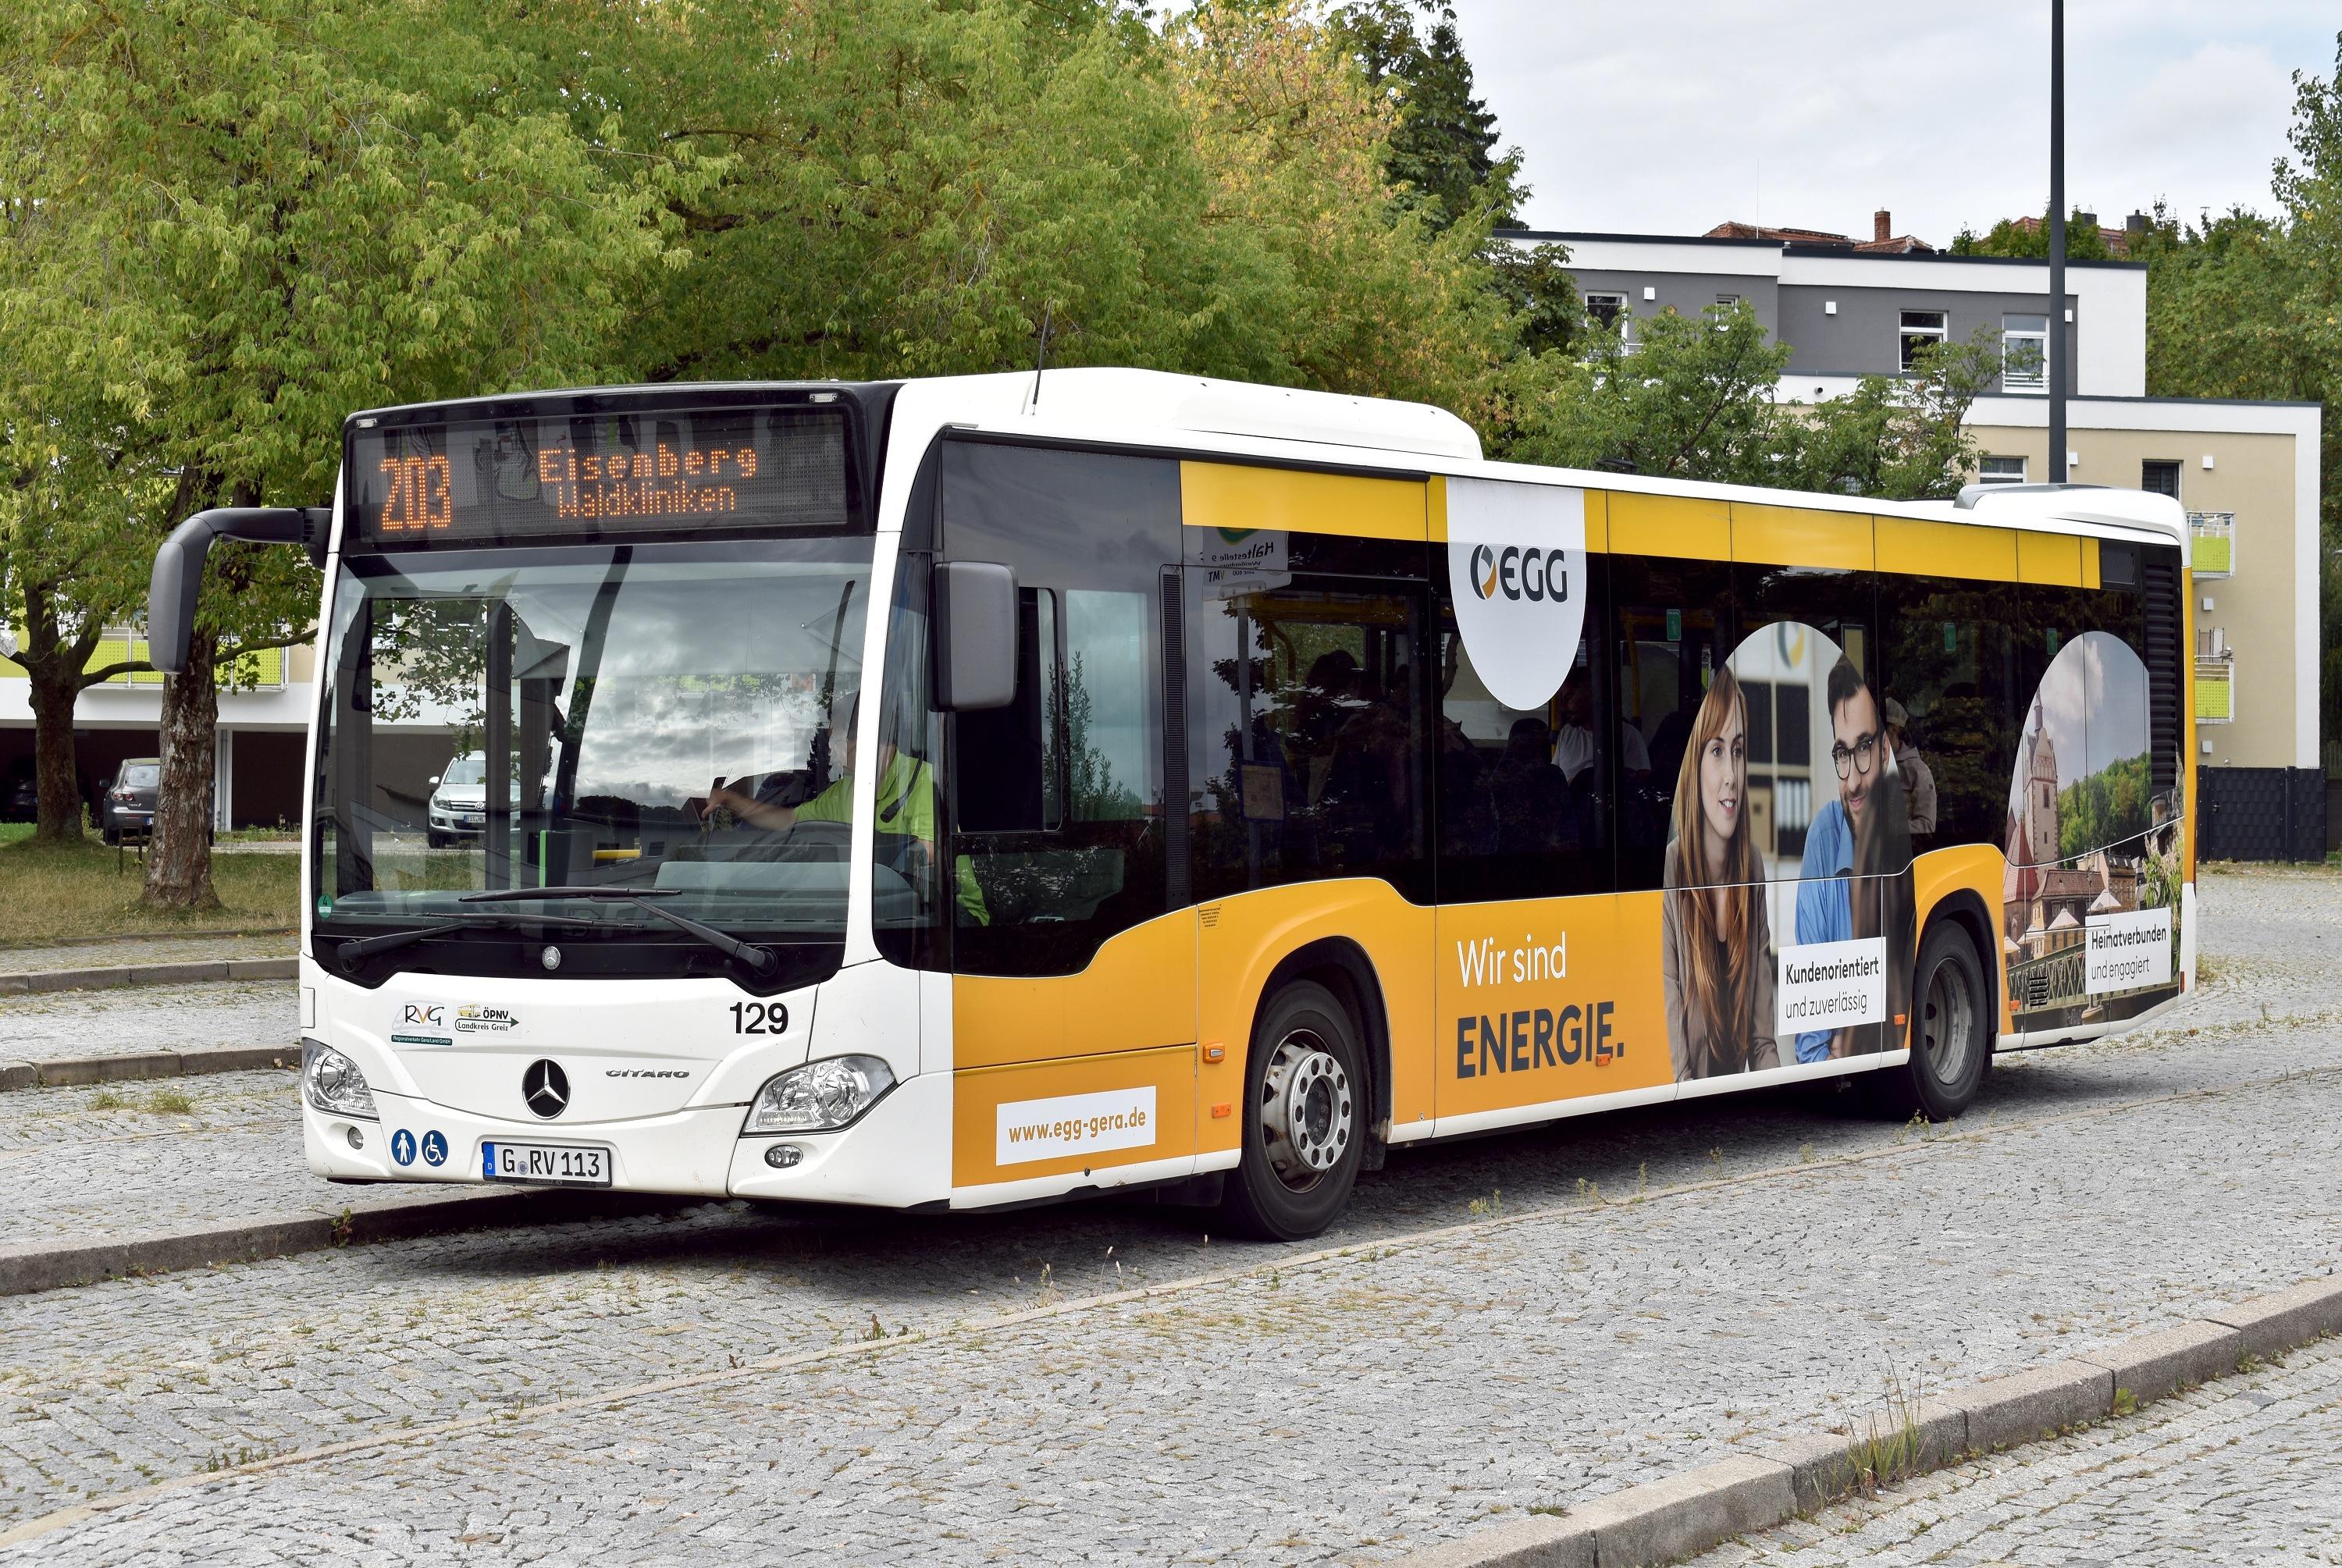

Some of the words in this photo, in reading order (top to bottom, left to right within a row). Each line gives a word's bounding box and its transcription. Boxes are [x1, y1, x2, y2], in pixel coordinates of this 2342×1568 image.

[539, 443, 758, 483] Eisenberg
[381, 456, 451, 530] 203
[557, 480, 736, 518] Waldkliniken
[1499, 546, 1568, 603] EGG
[322, 894, 328, 906] 4
[2091, 923, 2166, 951] Heimatverbunden
[1457, 936, 1506, 987] Wir
[1513, 930, 1567, 983] sind
[1785, 956, 1879, 985] Kundenorientiert
[2091, 959, 2107, 980] und
[2109, 955, 2150, 981] engagiert
[404, 1004, 445, 1026] RVG
[482, 1006, 509, 1020] ÖPNV
[729, 1001, 788, 1035] 129
[1785, 995, 1806, 1019] und
[1809, 989, 1867, 1016] zuverlässig
[457, 1020, 489, 1031] Landkreis
[491, 1021, 509, 1032] Greiz
[1457, 1001, 1625, 1079] ENERGIE.
[605, 1068, 690, 1079] CITARO
[1009, 1106, 1147, 1143] www.egg-gera.de
